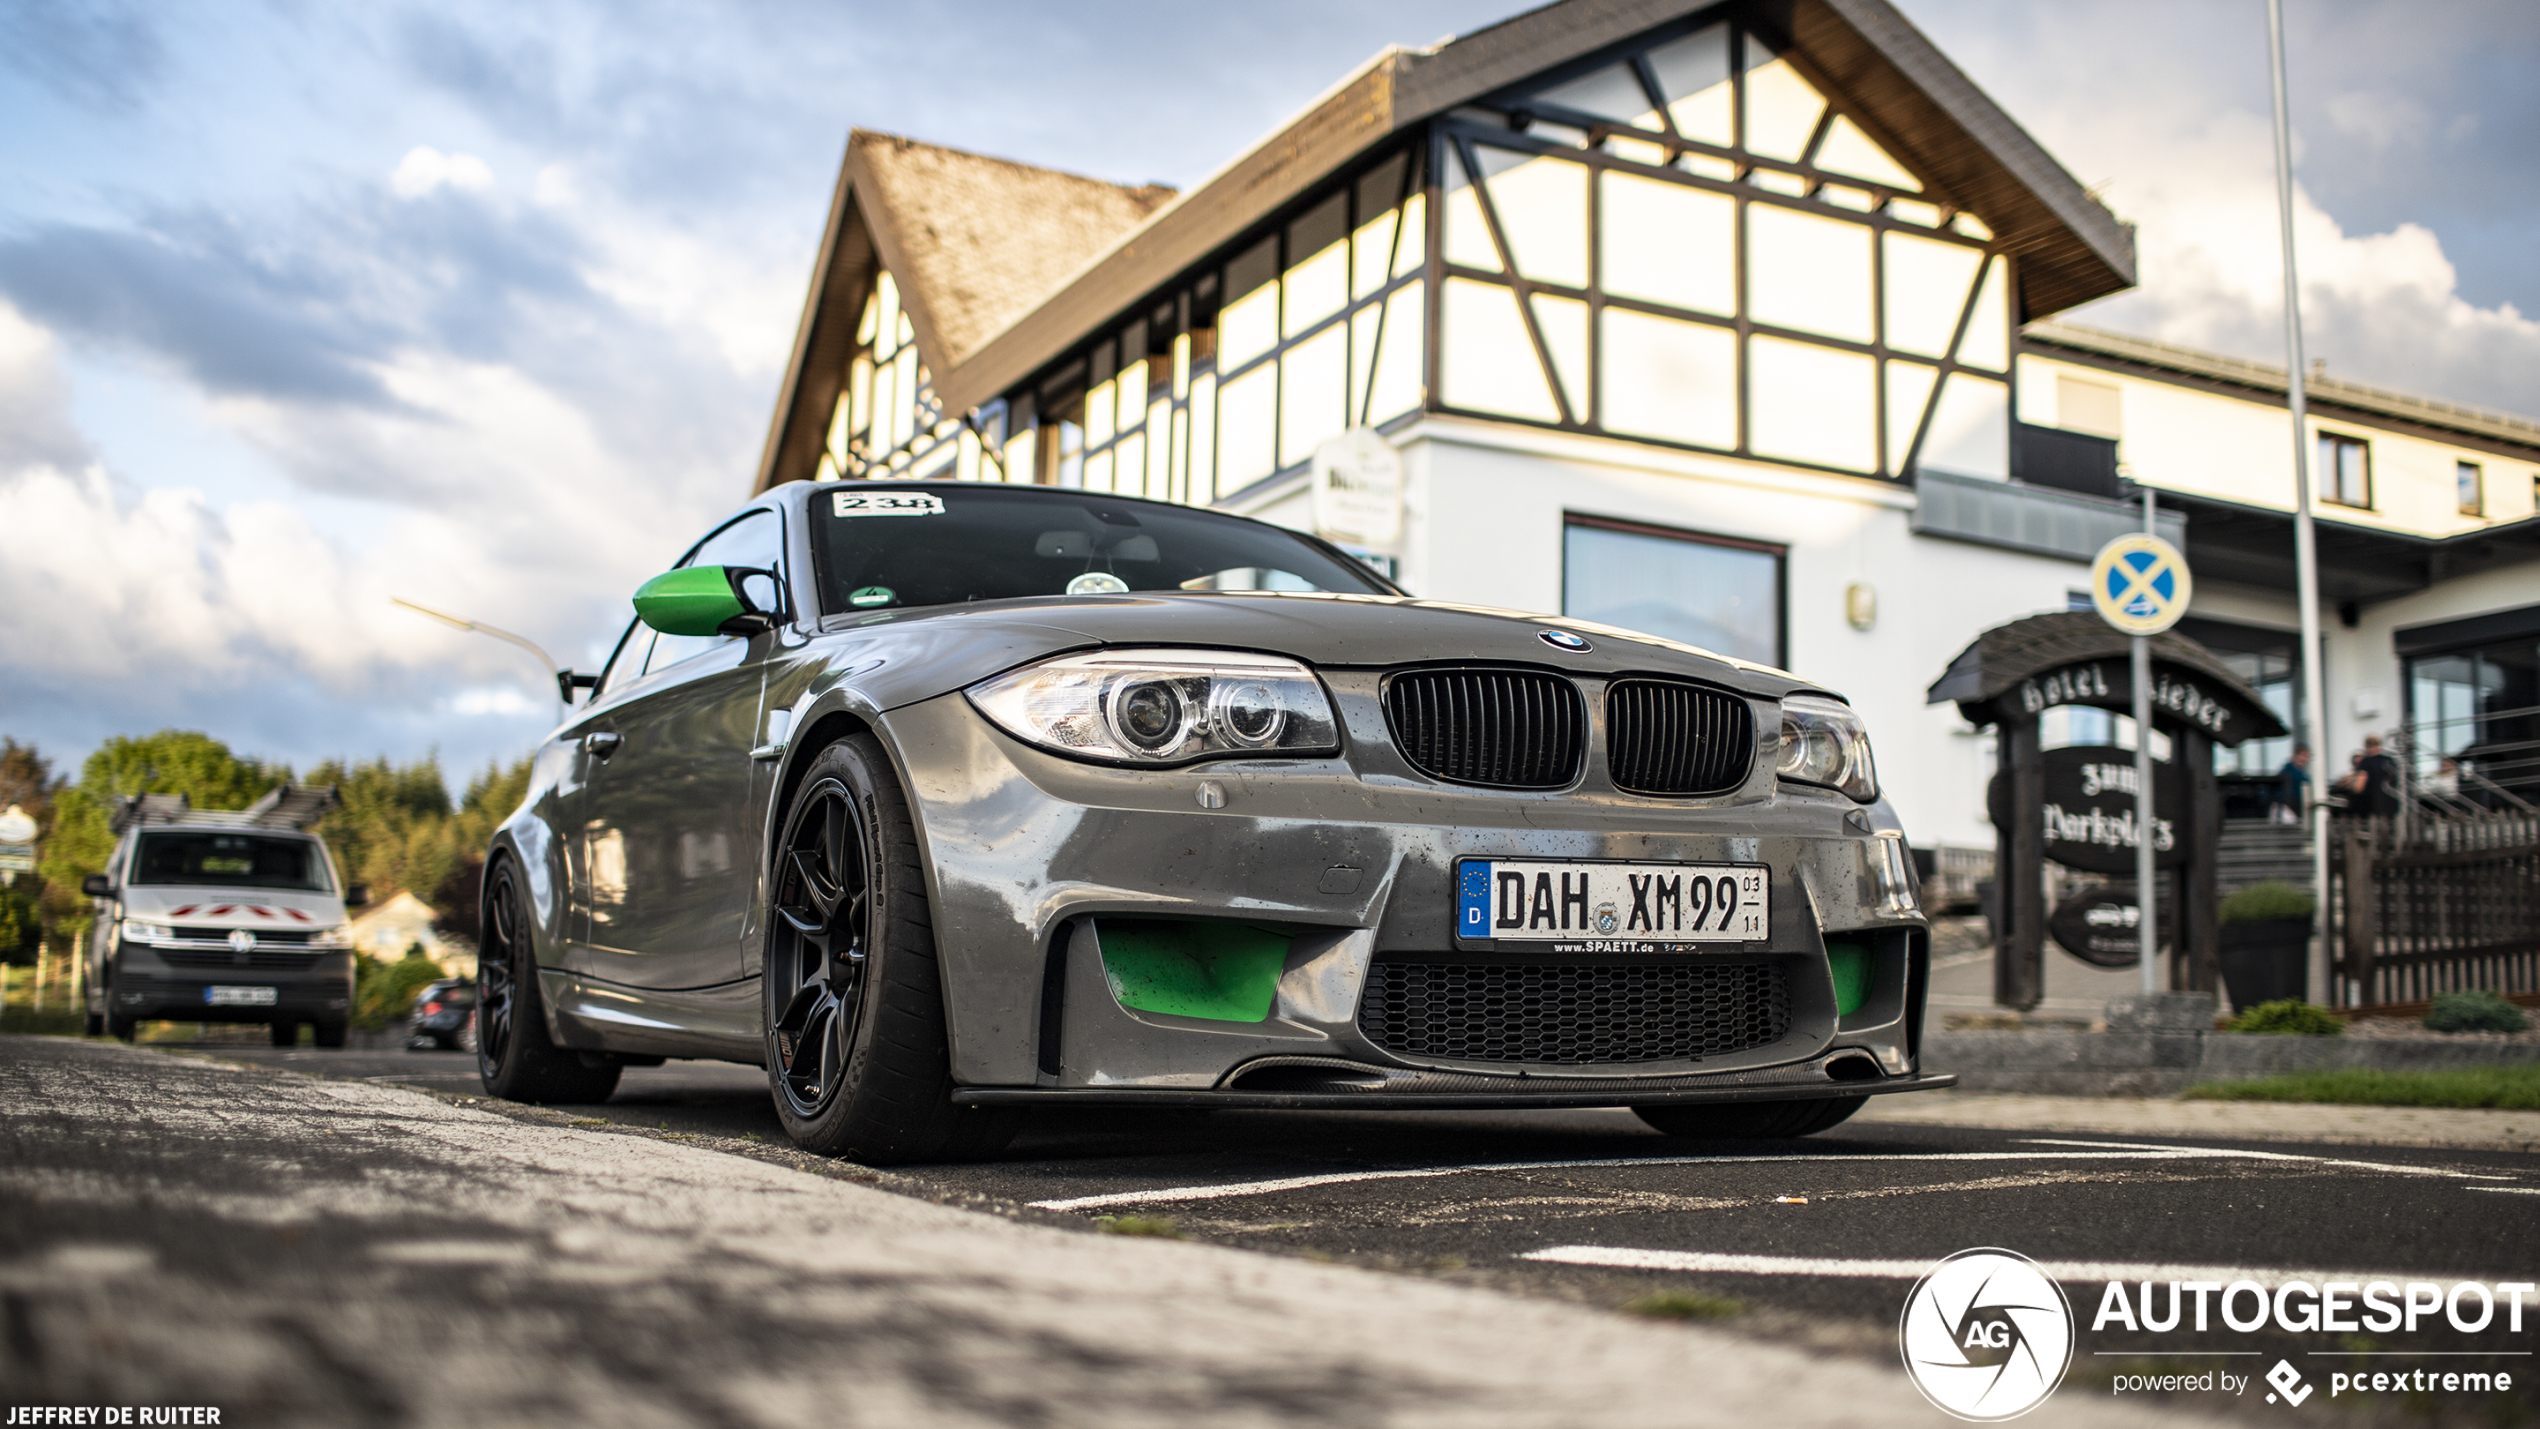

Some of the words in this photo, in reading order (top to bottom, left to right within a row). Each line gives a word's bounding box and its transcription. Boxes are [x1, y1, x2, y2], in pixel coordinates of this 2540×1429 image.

[842, 498, 935, 509] 238
[2021, 663, 2108, 712] Hotel
[2149, 672, 2230, 732] ieder
[1743, 876, 1760, 892] 03
[1496, 870, 1589, 930] DAH
[1468, 907, 1481, 924] D
[1743, 914, 1760, 932] 11
[1554, 941, 1654, 953] www.SPAETT.de
